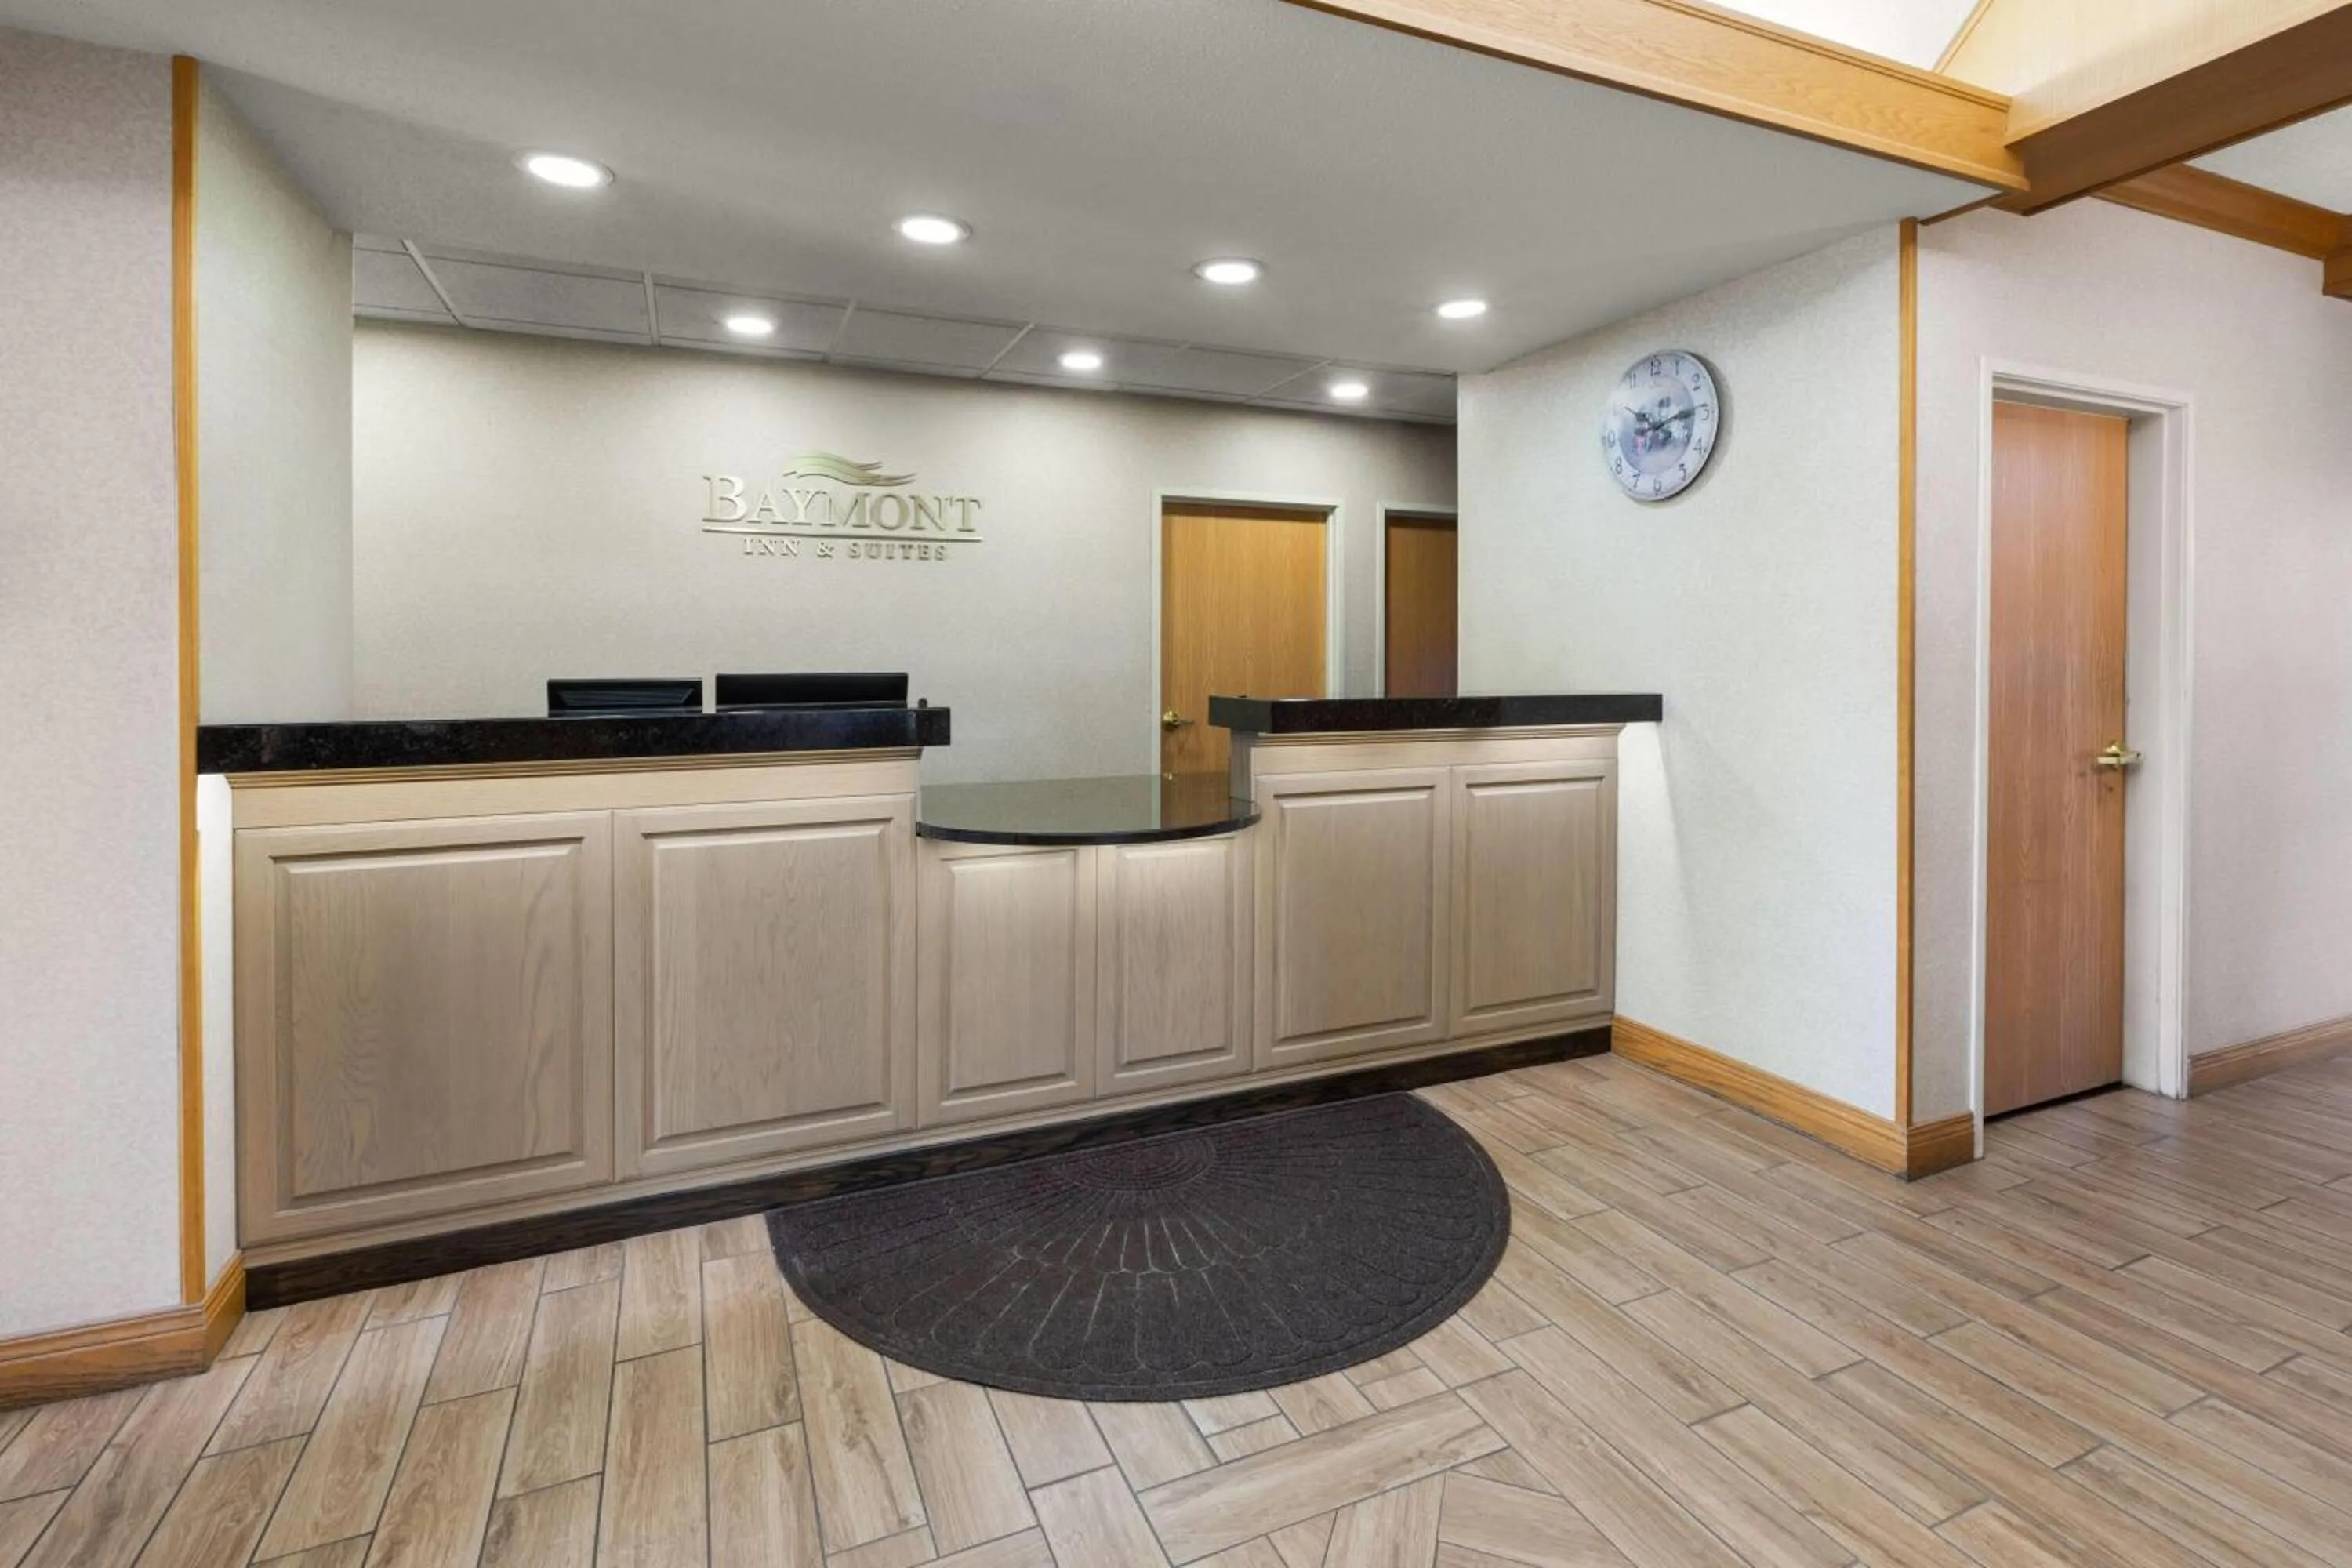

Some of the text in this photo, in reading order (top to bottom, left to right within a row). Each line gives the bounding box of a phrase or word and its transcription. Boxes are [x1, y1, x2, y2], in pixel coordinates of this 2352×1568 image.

[702, 475, 982, 532] BAYMONT
[743, 539, 947, 561] INN & SUITES
